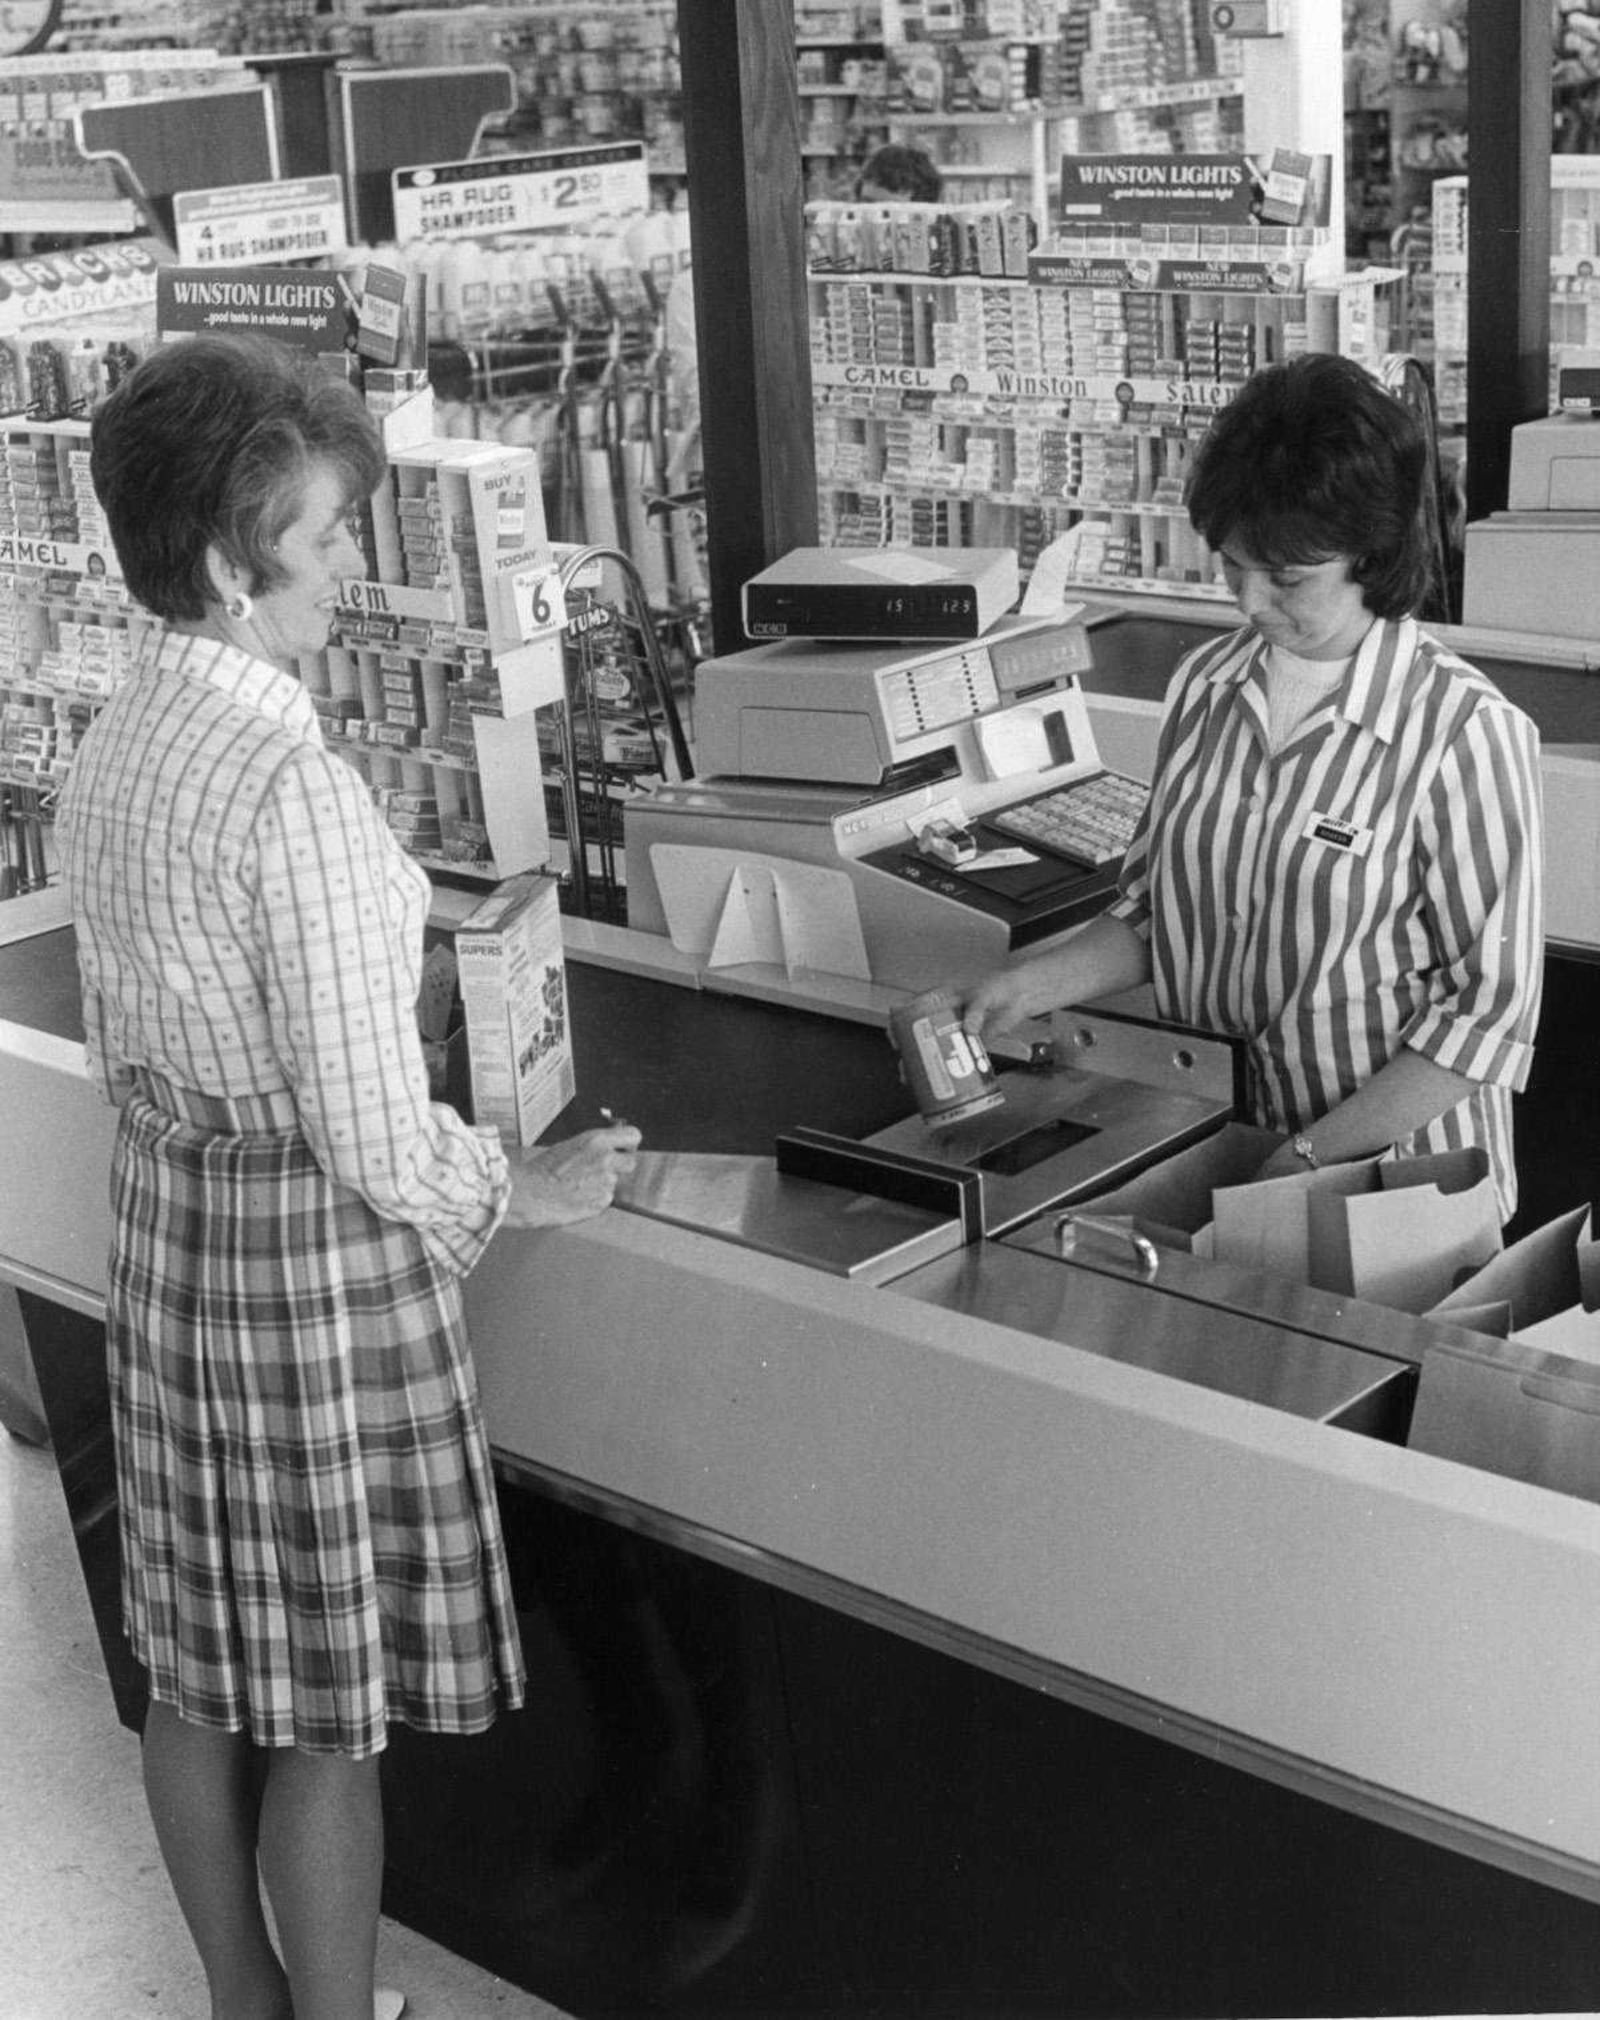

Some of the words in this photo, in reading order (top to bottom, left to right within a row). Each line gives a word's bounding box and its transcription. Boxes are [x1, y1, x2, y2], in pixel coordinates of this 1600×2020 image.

[1078, 165, 1167, 185] WINSTON
[1170, 165, 1243, 185] LIGHTS
[173, 281, 261, 307] WINSTON
[264, 284, 336, 309] LIGHTS
[844, 367, 929, 387] CAMEL
[996, 372, 1087, 398] Winston
[484, 475, 512, 491] BUY
[495, 551, 537, 570] TODAY
[531, 581, 551, 624] 6
[567, 608, 610, 636] TUMS
